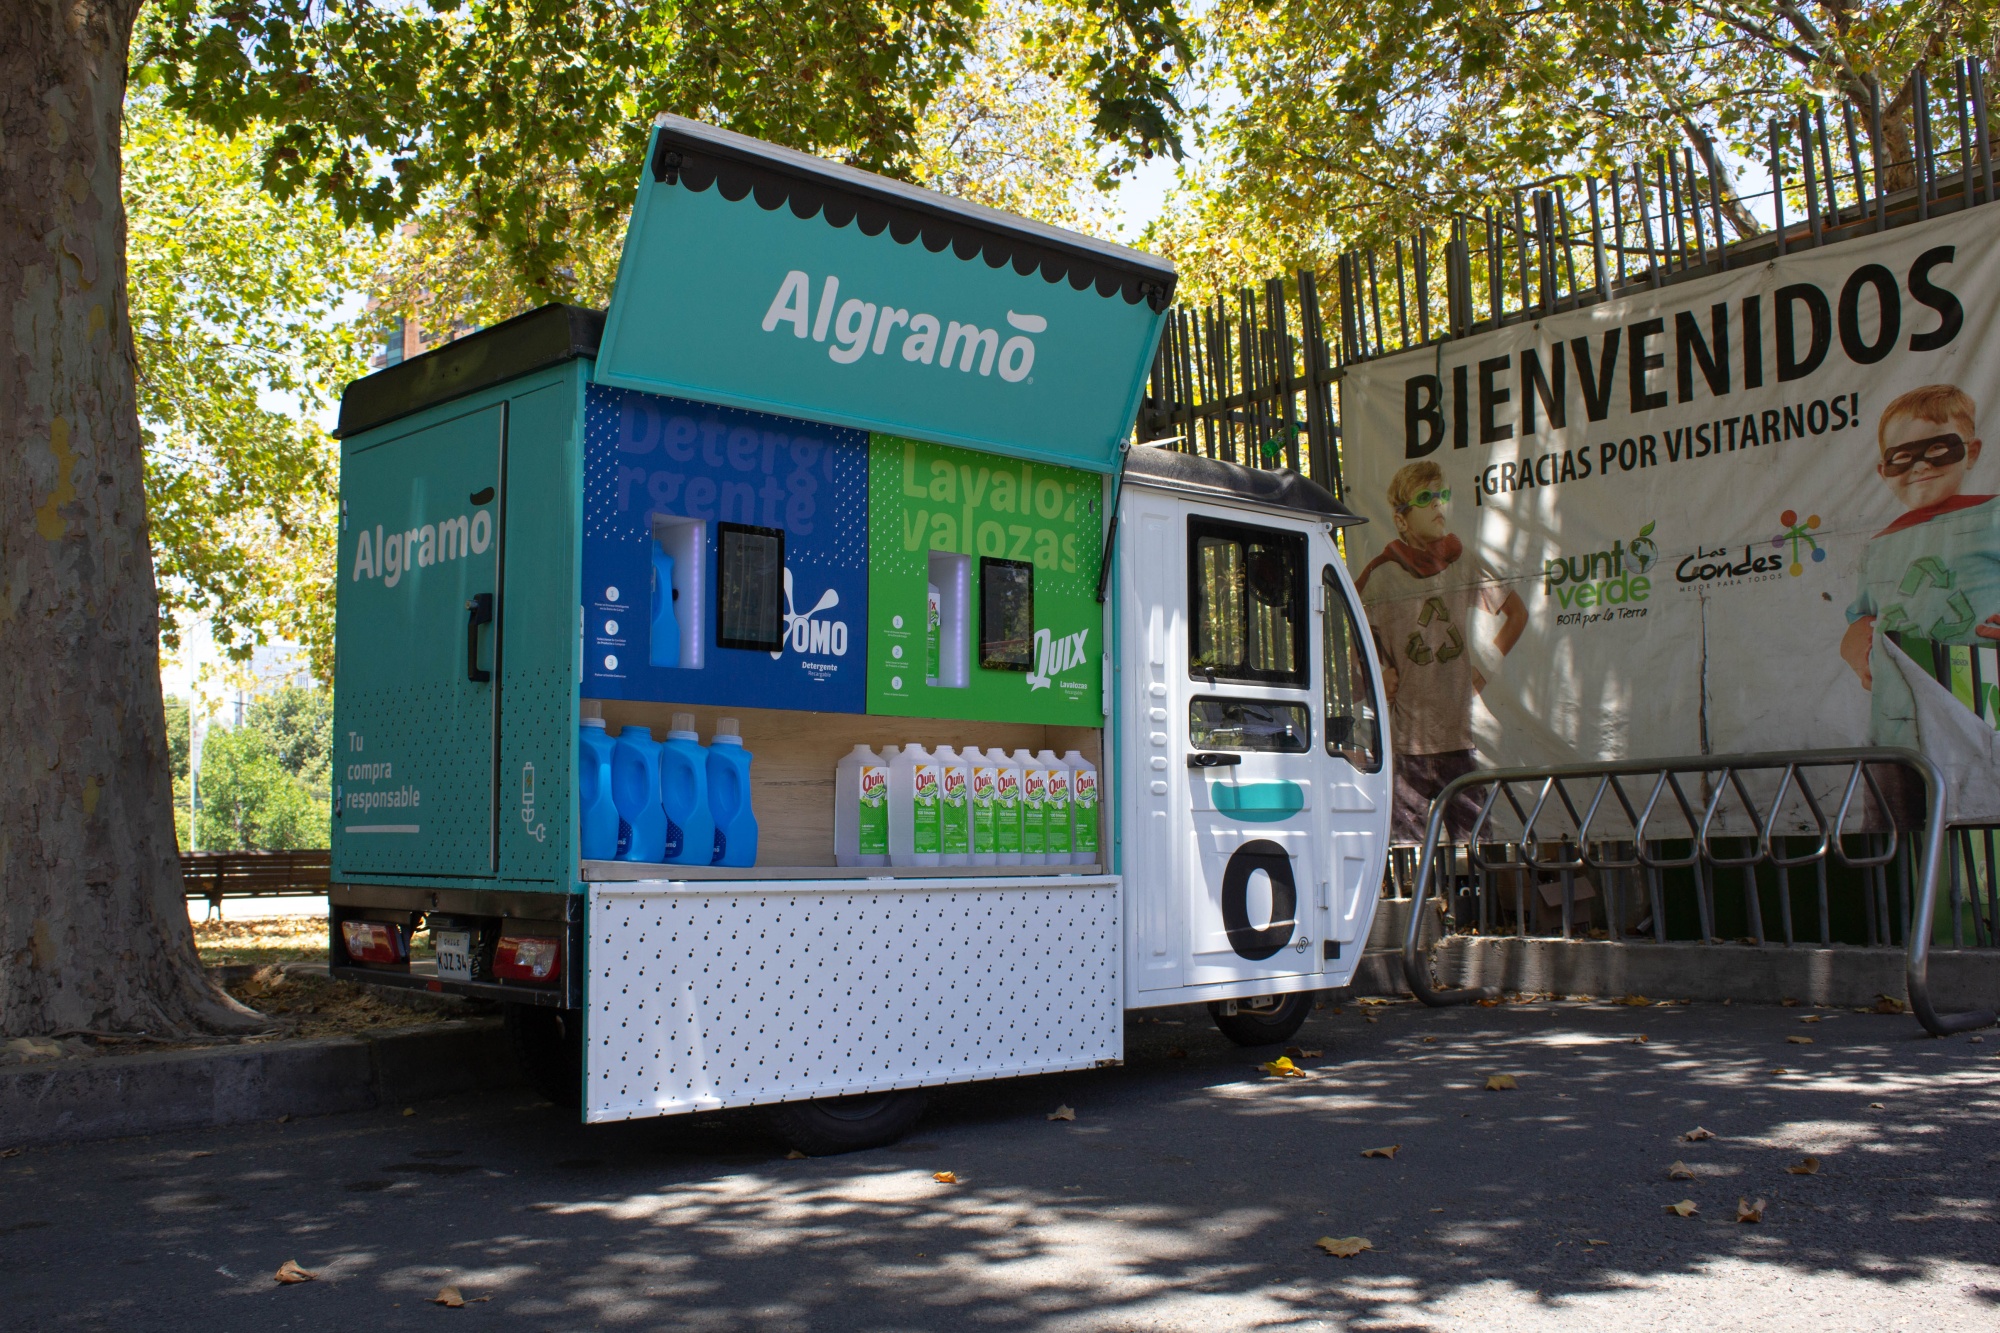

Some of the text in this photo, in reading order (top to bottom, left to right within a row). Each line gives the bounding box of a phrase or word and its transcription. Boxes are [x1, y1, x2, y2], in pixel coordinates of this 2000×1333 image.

[1404, 245, 1964, 460] BIENVENIDOS
[1474, 392, 1859, 507] ¡GRACIAS POR VISITARNOS!
[1675, 544, 1783, 583] Condes
[1698, 545, 1727, 558] Las
[1556, 570, 1651, 610] verde
[1679, 573, 1783, 593] MEJOR PARA TODOS
[1556, 607, 1648, 629] BOTA por la Tierra
[792, 616, 848, 657] OMO
[801, 661, 838, 672] Detergente
[1060, 681, 1088, 690] Lavalozas
[348, 731, 364, 752] Tu
[347, 760, 392, 786] compra
[346, 784, 420, 814] responsable
[443, 938, 460, 947] CHILE
